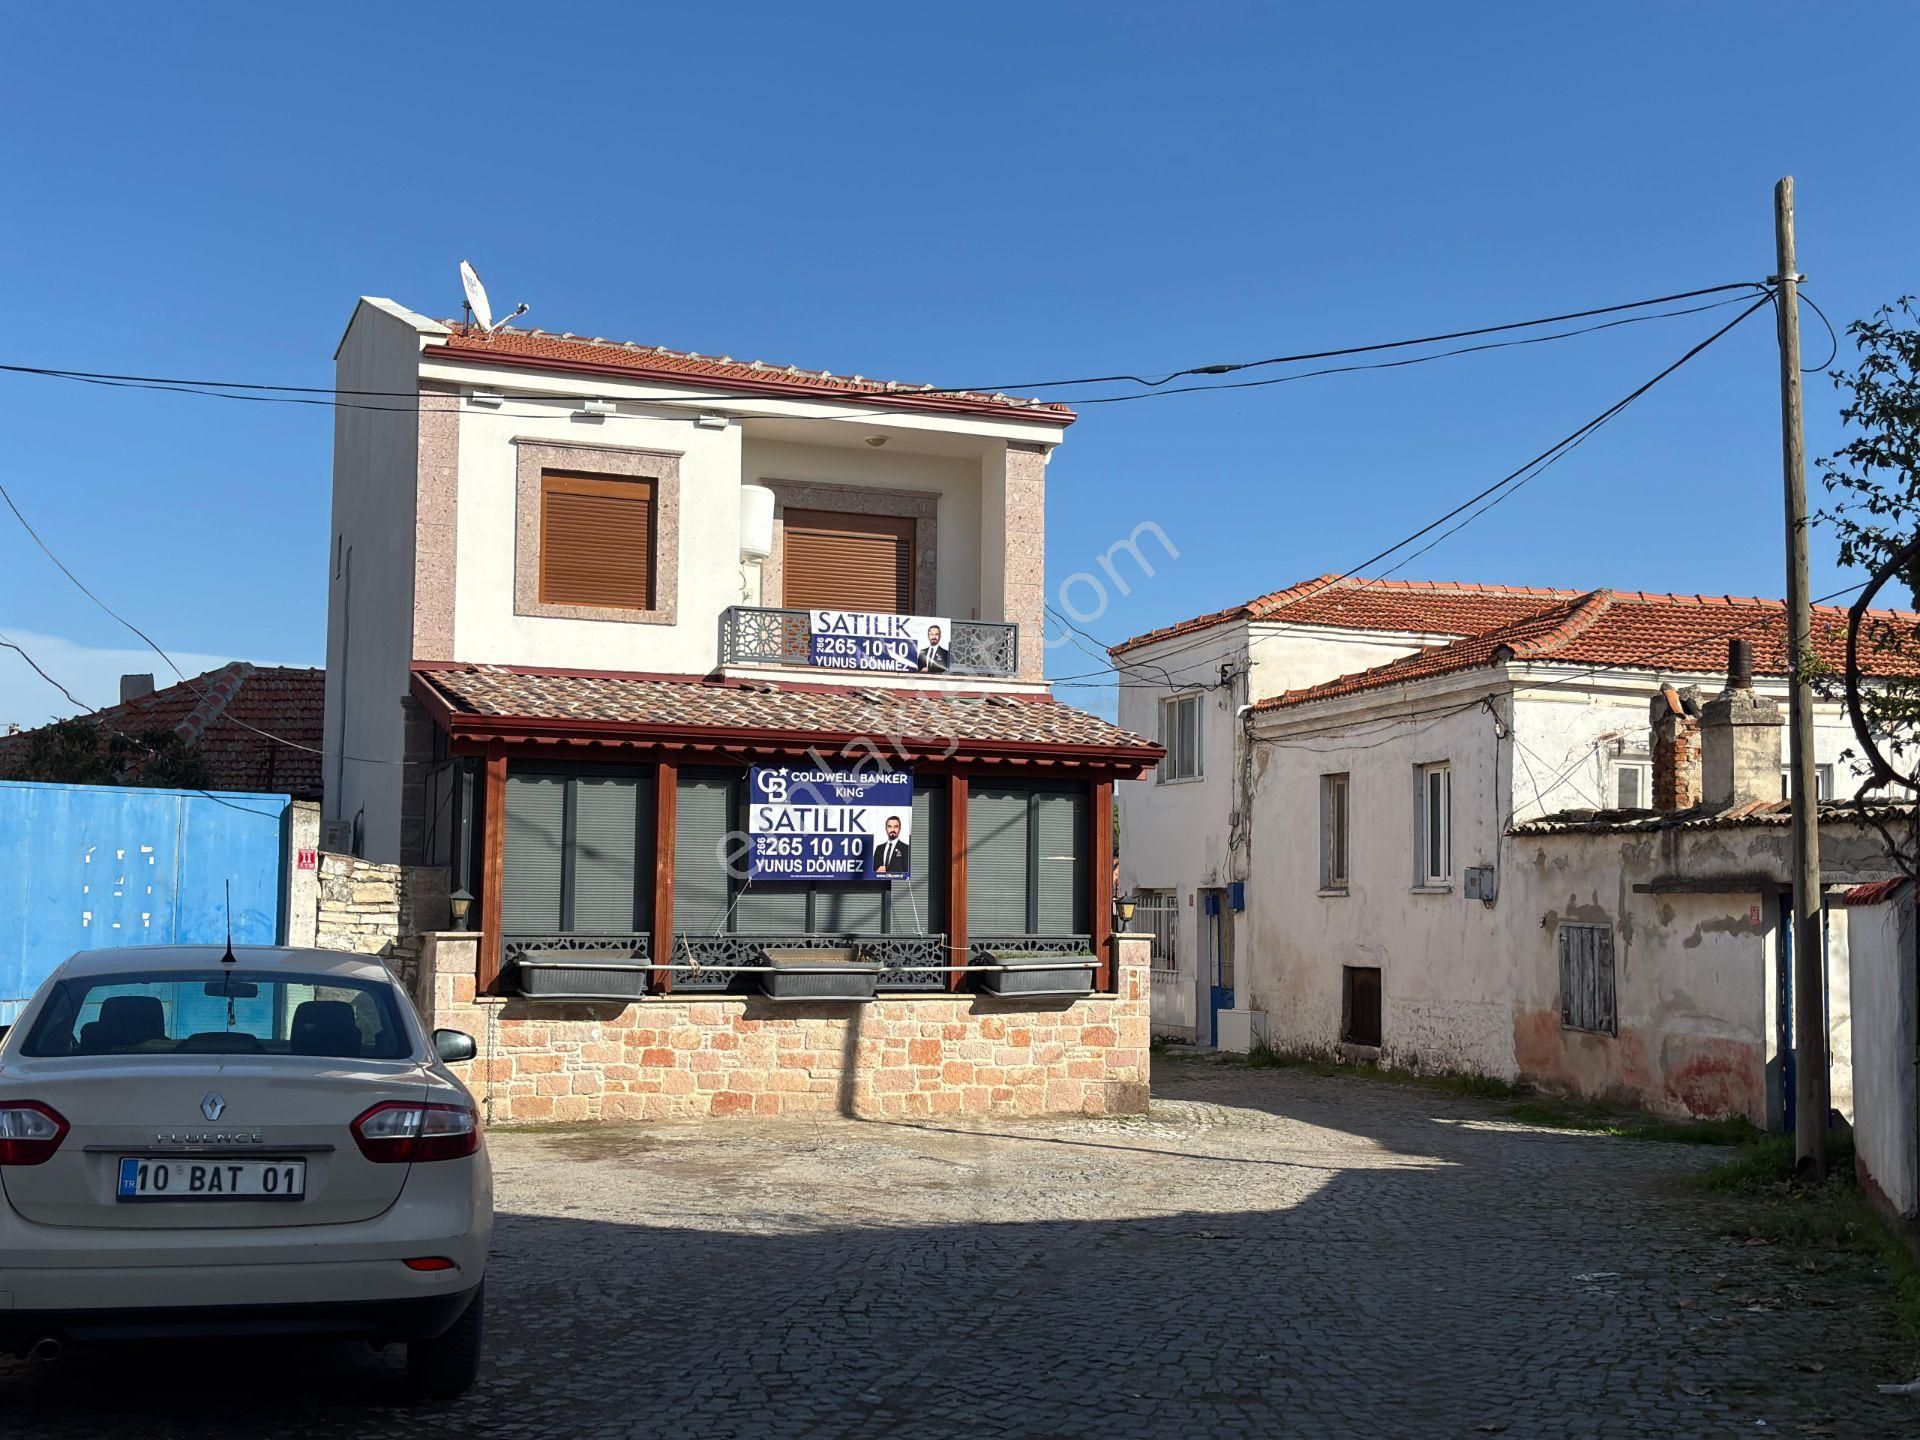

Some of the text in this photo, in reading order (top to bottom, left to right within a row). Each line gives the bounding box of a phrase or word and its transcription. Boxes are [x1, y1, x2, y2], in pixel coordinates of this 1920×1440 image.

[818, 611, 912, 638] SATILIK
[816, 637, 824, 653] 266
[824, 637, 856, 654] 265
[862, 641, 883, 656] 10
[815, 655, 910, 672] YUNUS DÖNMEZ
[791, 771, 908, 784] COLDWELL BANKER
[759, 806, 867, 832] SATILIK
[756, 836, 863, 856] 266 265 10 10
[756, 856, 864, 873] YUNUS DÖNMEZ
[157, 1133, 264, 1144] FLUENCE
[124, 1179, 135, 1188] TR
[138, 1165, 294, 1193] 10 BAT 01
